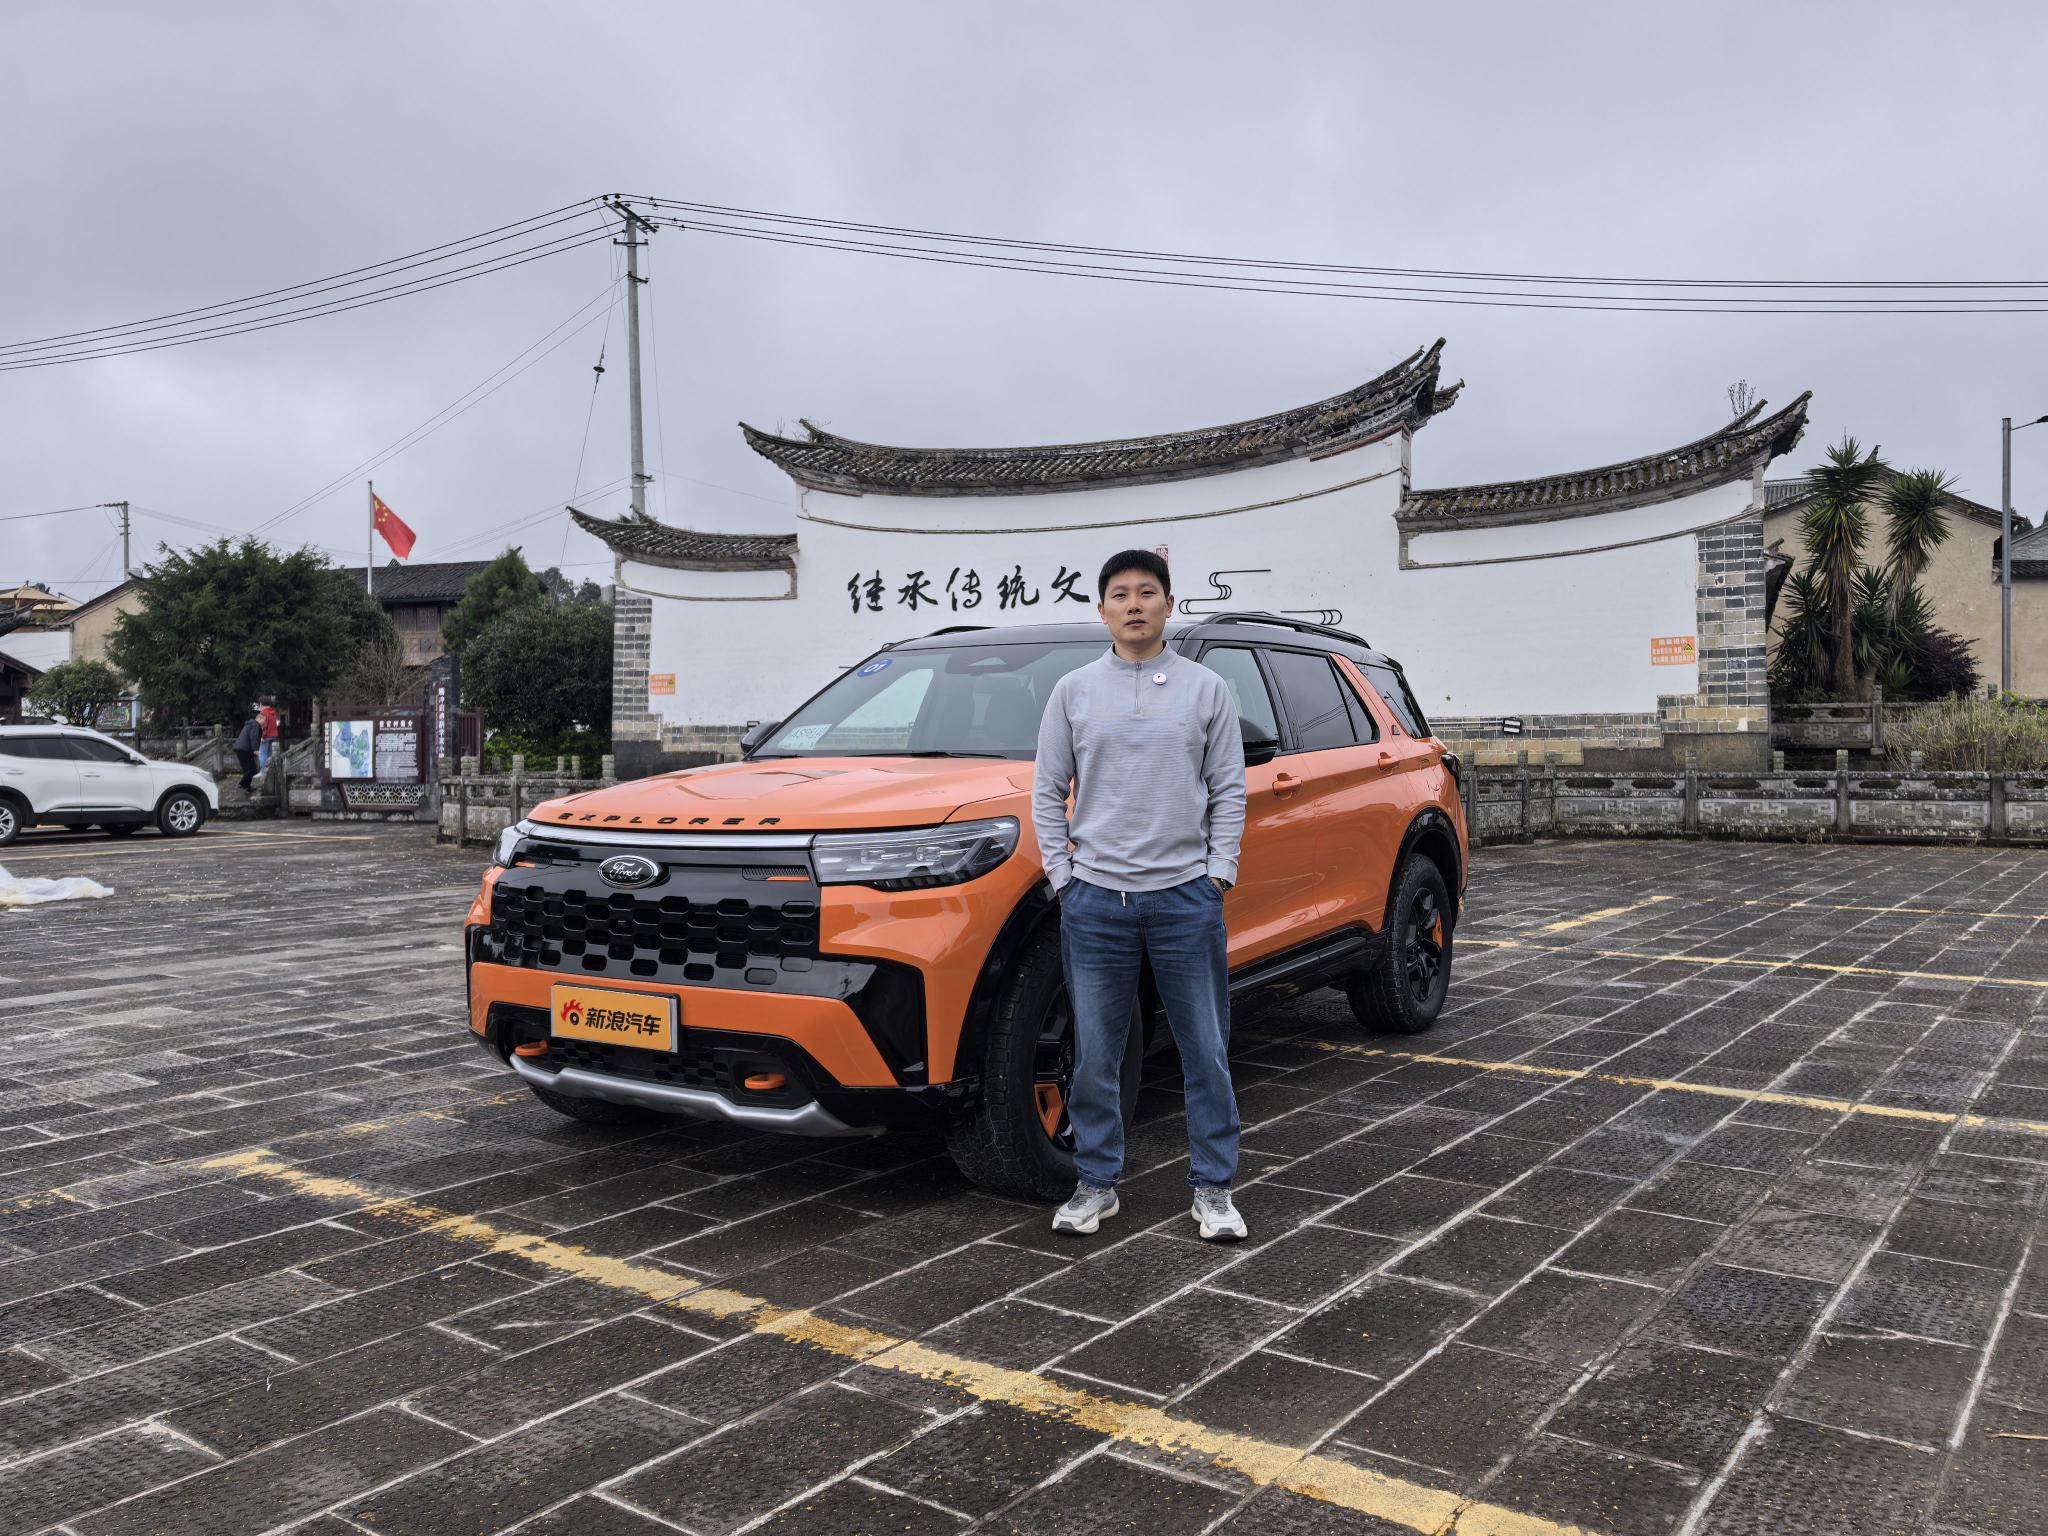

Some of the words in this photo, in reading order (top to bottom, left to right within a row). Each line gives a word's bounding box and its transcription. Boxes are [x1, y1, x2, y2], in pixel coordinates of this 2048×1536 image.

[847, 565, 1091, 614] 继承传统文
[558, 812, 781, 825] EXPLORER
[611, 861, 641, 877] Ford
[584, 1007, 662, 1036] 新浪汽车
